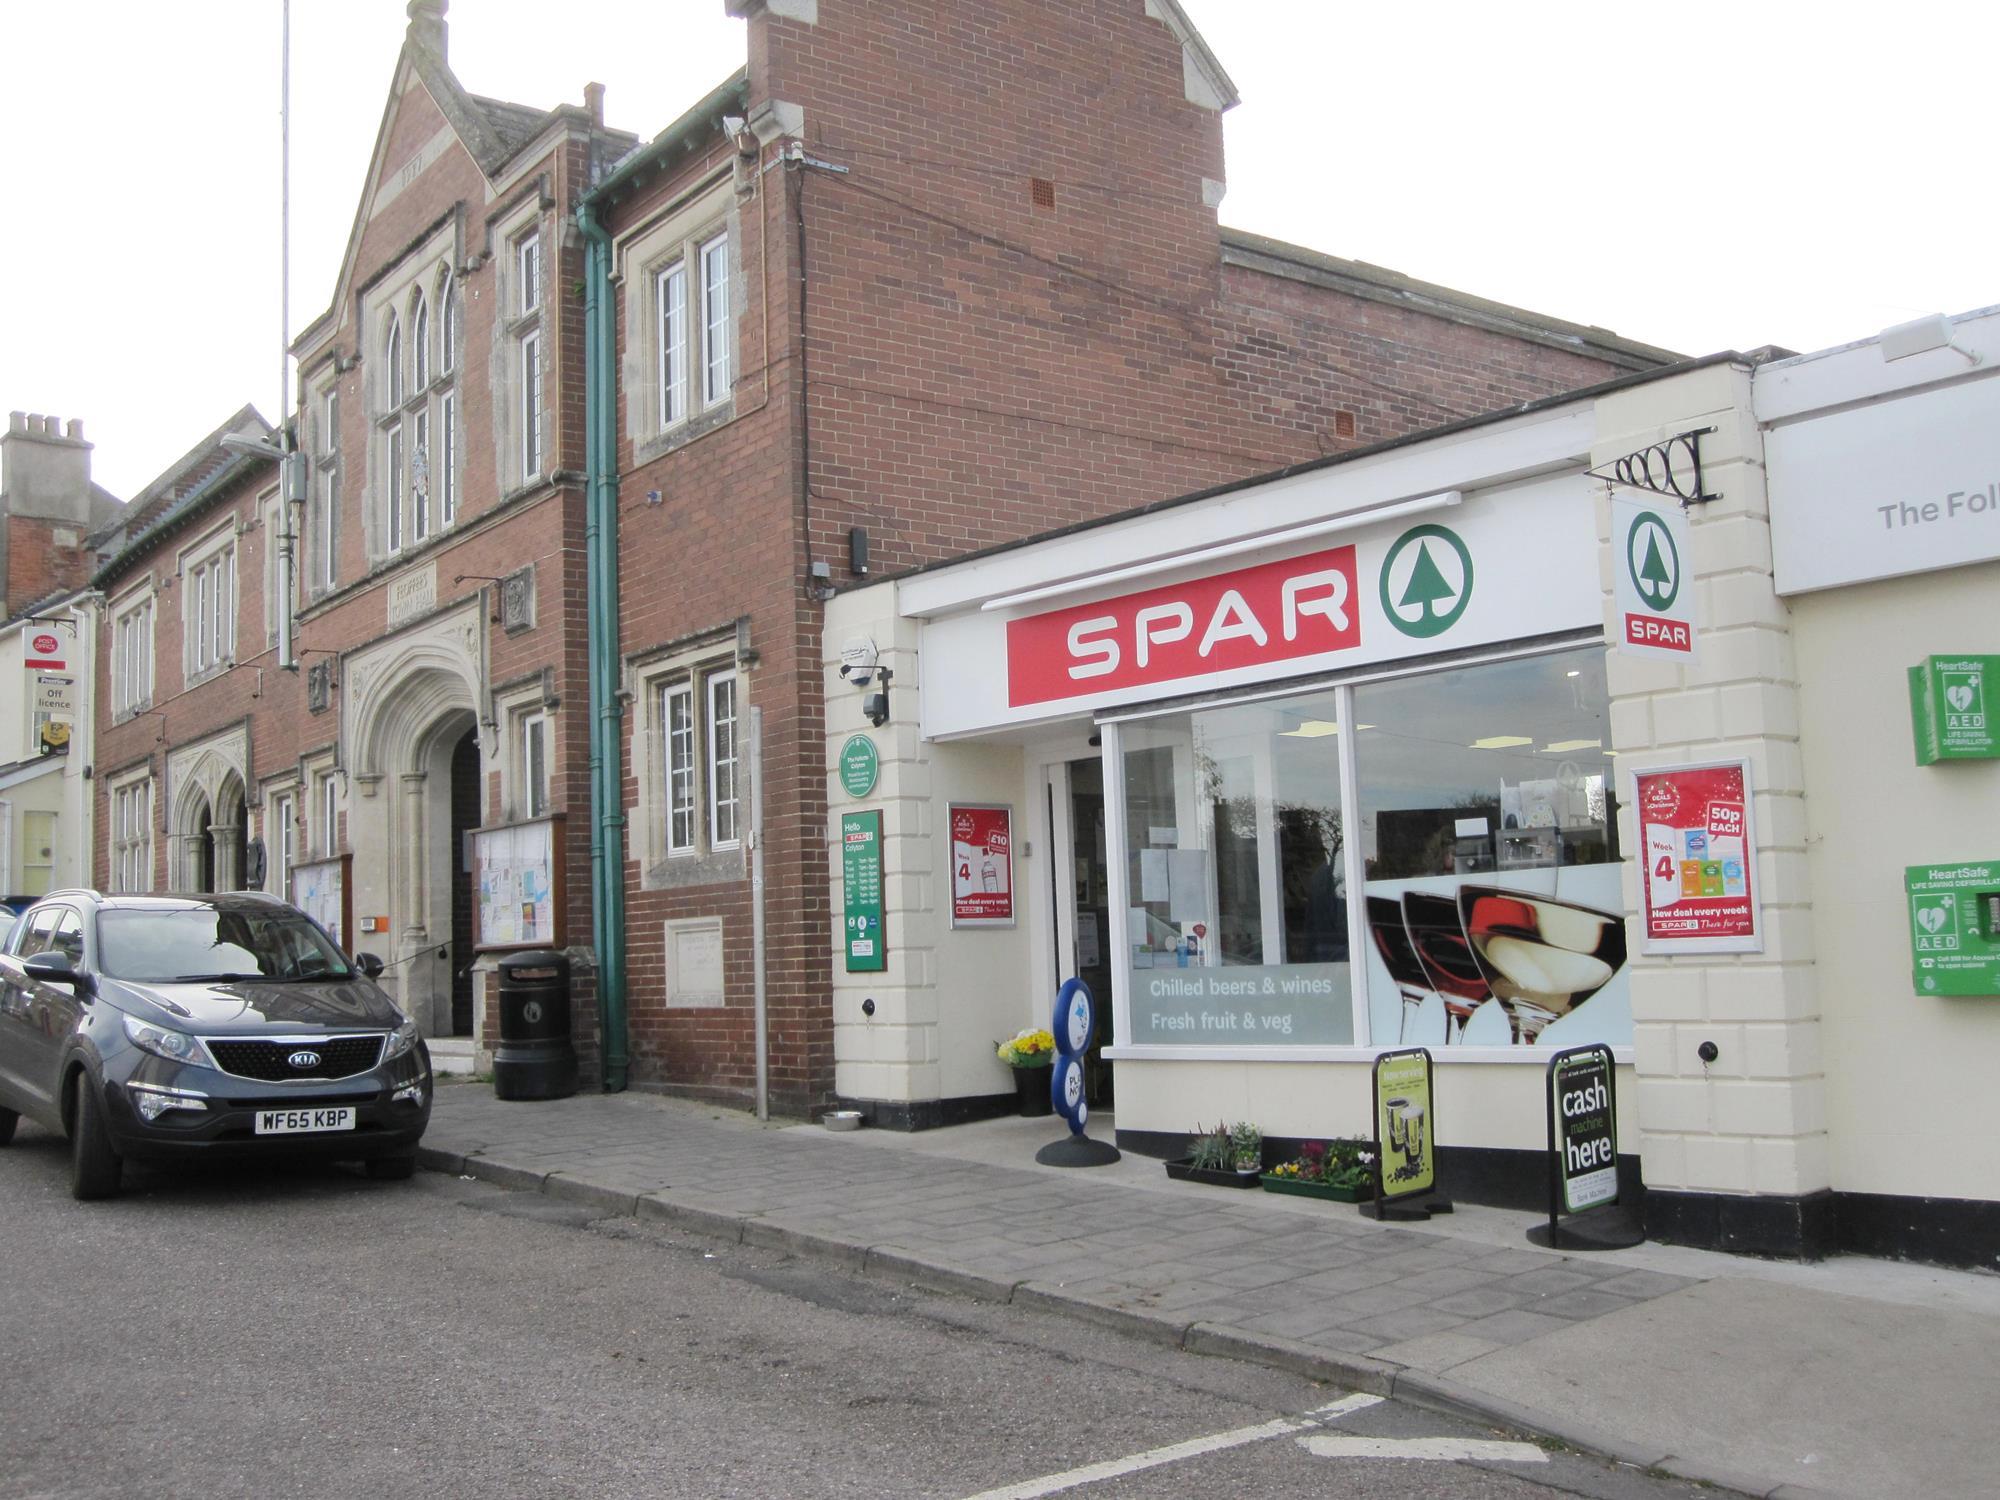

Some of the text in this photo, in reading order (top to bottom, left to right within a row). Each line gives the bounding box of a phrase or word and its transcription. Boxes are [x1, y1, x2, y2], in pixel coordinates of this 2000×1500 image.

[1878, 482, 2000, 529] The Fol
[1067, 568, 1349, 680] SPAR
[1631, 620, 1686, 645] SPAR
[1935, 661, 1984, 671] HeartSafe
[47, 689, 63, 698] Off
[38, 698, 71, 709] licence
[1949, 715, 1982, 727] AED
[1711, 807, 1741, 822] 50p
[844, 822, 861, 832] Hello
[1710, 823, 1740, 833] EACH
[991, 834, 1007, 846] £10
[1652, 841, 1674, 851] Week
[845, 844, 865, 852] Colyton
[958, 863, 971, 880] 4
[1654, 855, 1675, 882] 4
[1929, 867, 1989, 880] HeartSafe
[1652, 905, 1748, 918] New deal every week
[1700, 920, 1720, 929] There
[1723, 919, 1735, 929] for
[1735, 921, 1749, 931] you
[1919, 936, 1956, 949] AED
[1150, 975, 1332, 997] Chilled beers & wines
[1151, 1011, 1292, 1034] Fresh fruit & veg
[294, 1055, 317, 1065] KIA
[1563, 1076, 1607, 1117] cash
[263, 1110, 348, 1130] WF65 KBP
[1570, 1116, 1604, 1136] machine
[1566, 1136, 1612, 1172] here
